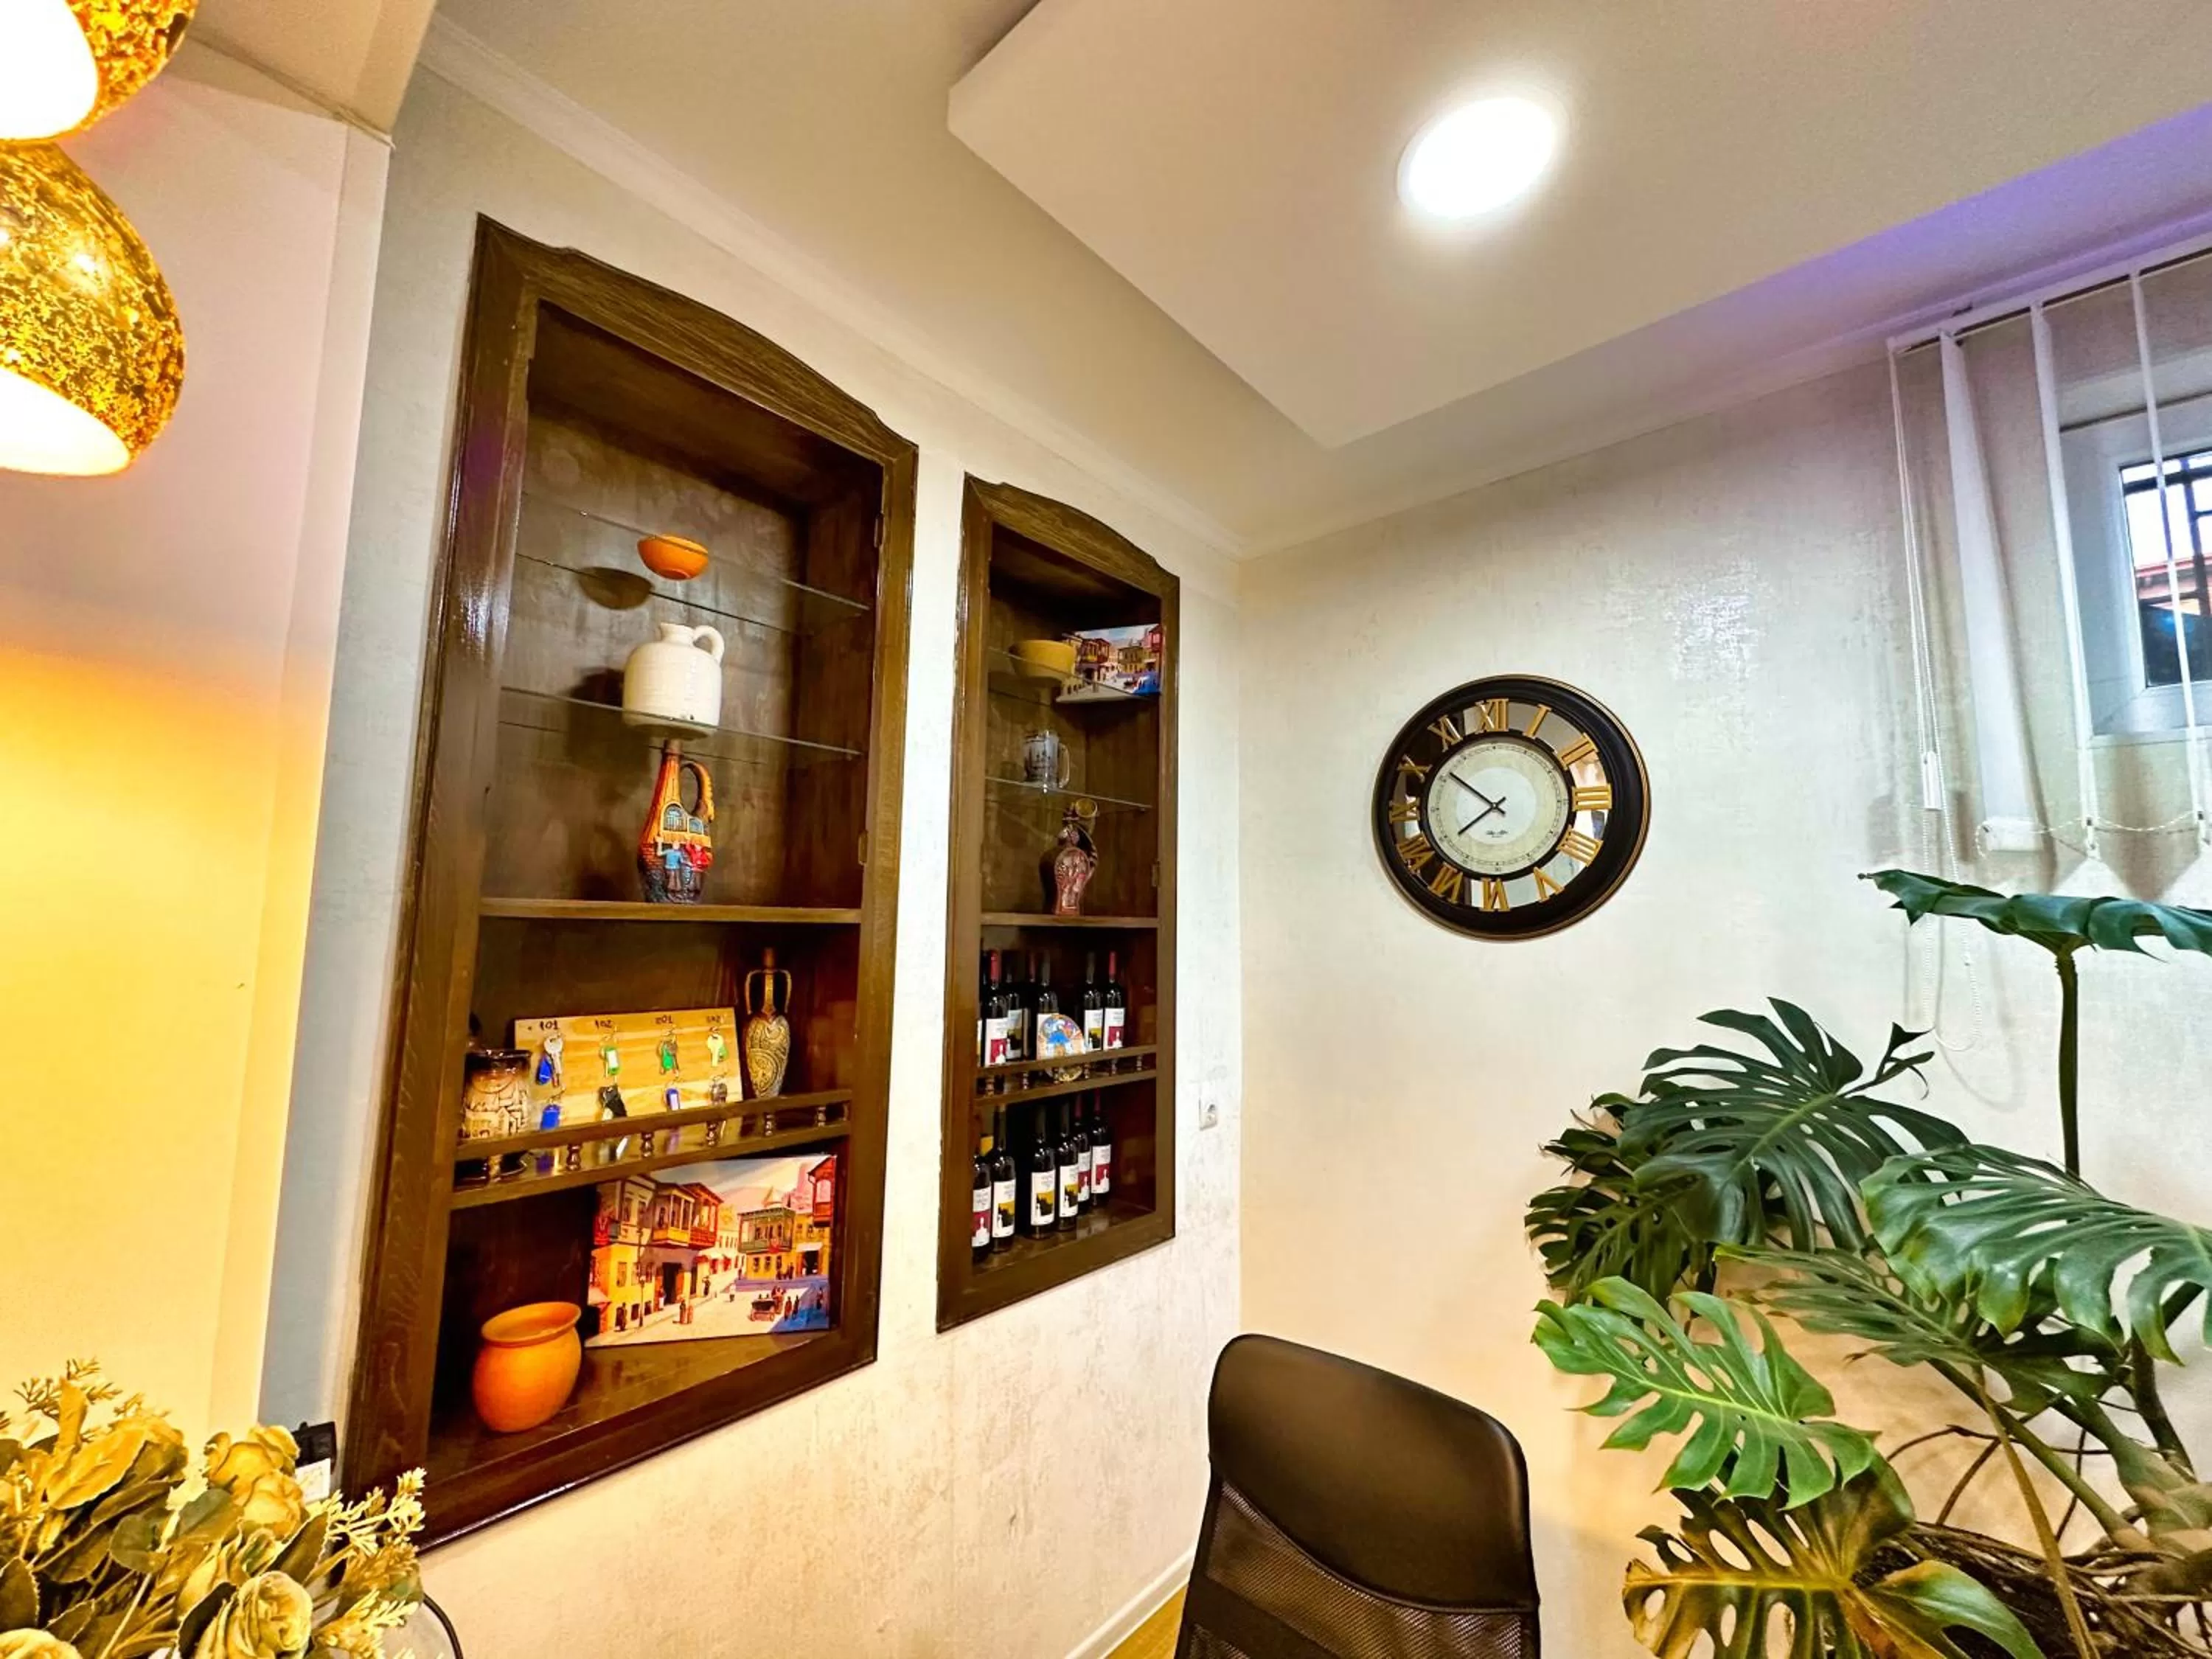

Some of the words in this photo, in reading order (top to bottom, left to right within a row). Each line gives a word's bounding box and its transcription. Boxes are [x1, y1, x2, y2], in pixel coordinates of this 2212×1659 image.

[1427, 714, 1464, 753] XI
[1475, 698, 1509, 734] XII
[1523, 703, 1551, 739] I
[1397, 754, 1433, 783] X
[1555, 732, 1599, 771] II
[1571, 783, 1613, 811] III
[1478, 877, 1511, 912] VI
[1533, 866, 1565, 903] V
[539, 1019, 559, 1031] 101
